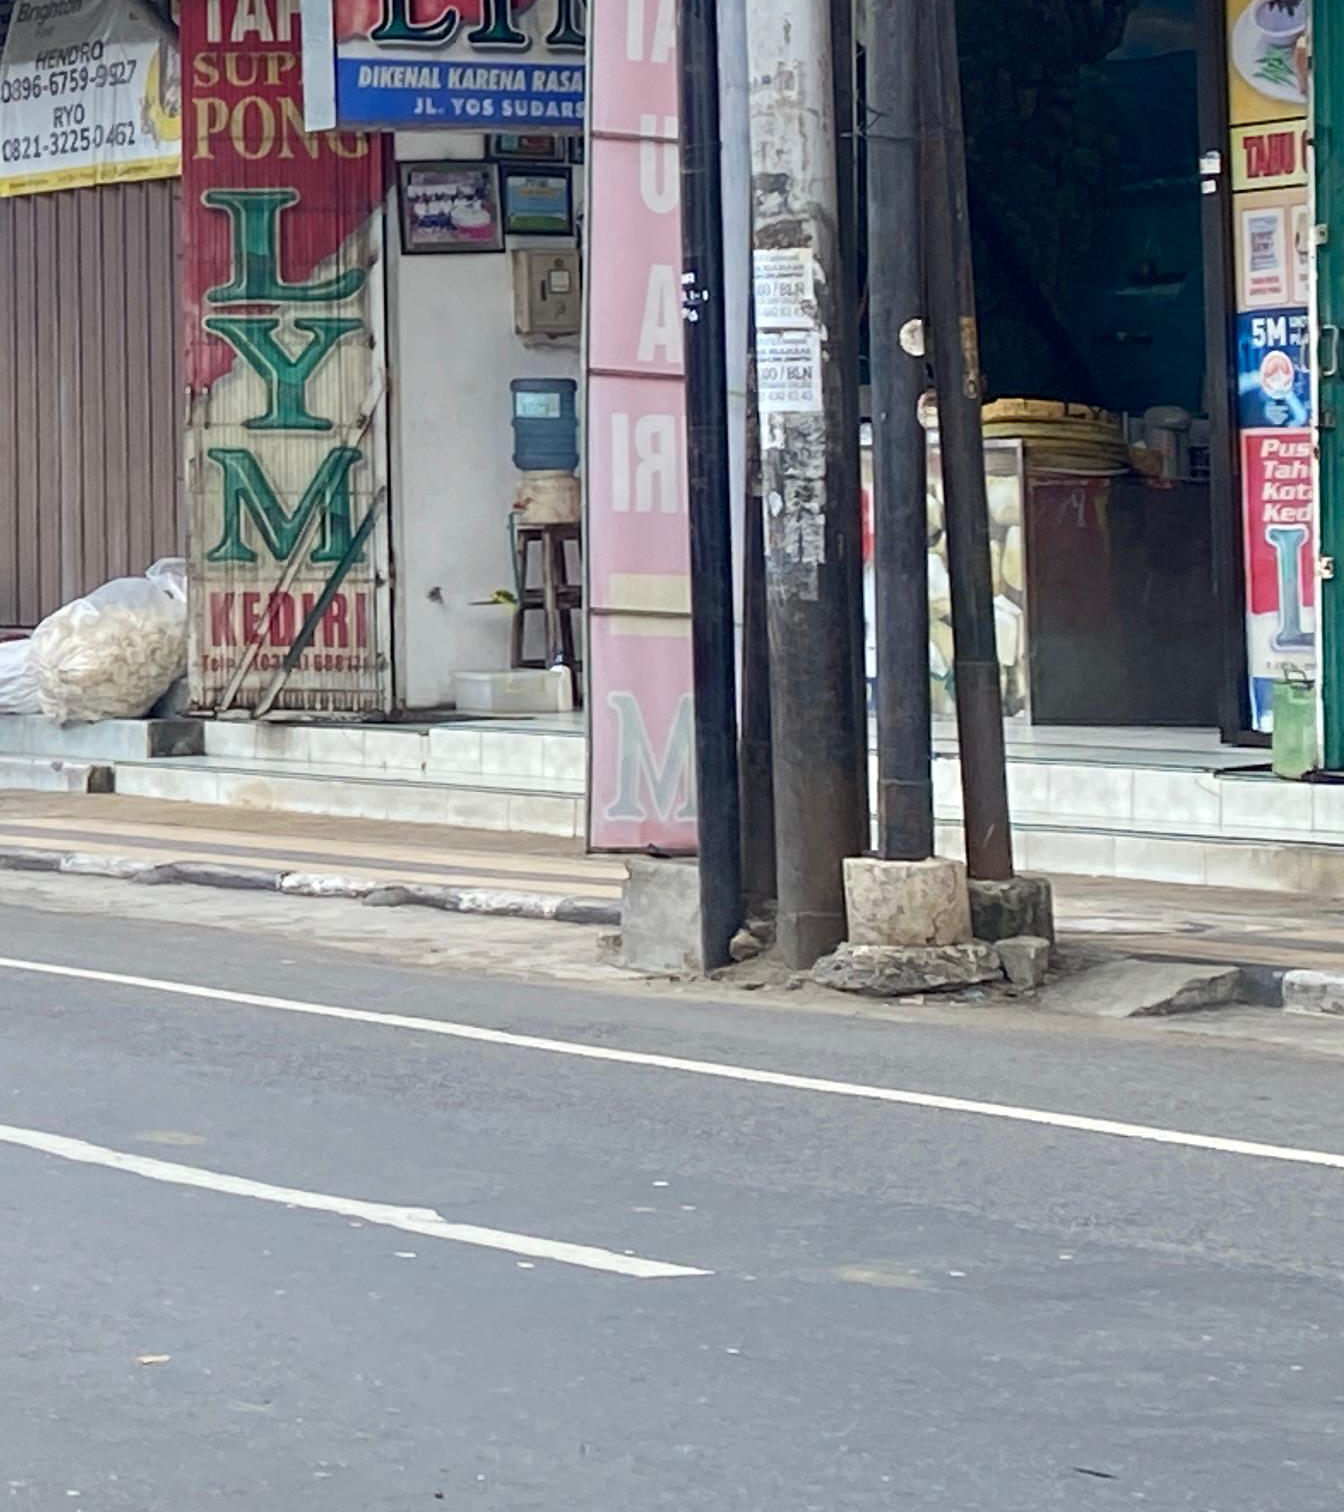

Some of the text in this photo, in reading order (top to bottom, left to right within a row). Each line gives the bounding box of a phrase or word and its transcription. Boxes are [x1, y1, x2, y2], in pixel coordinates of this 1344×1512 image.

[35, 40, 104, 71] HENDRO
[193, 52, 297, 87] SUP
[358, 65, 441, 89] DIKENAL
[448, 68, 527, 92] KARENA
[53, 103, 85, 128] RYO
[414, 97, 585, 118] JL. YOS SUDARS
[1251, 315, 1287, 347] 5M
[1260, 438, 1311, 458] Pus
[1263, 460, 1312, 480] Tah
[1263, 502, 1313, 523] Ked
[210, 592, 367, 648] KEDIRI
